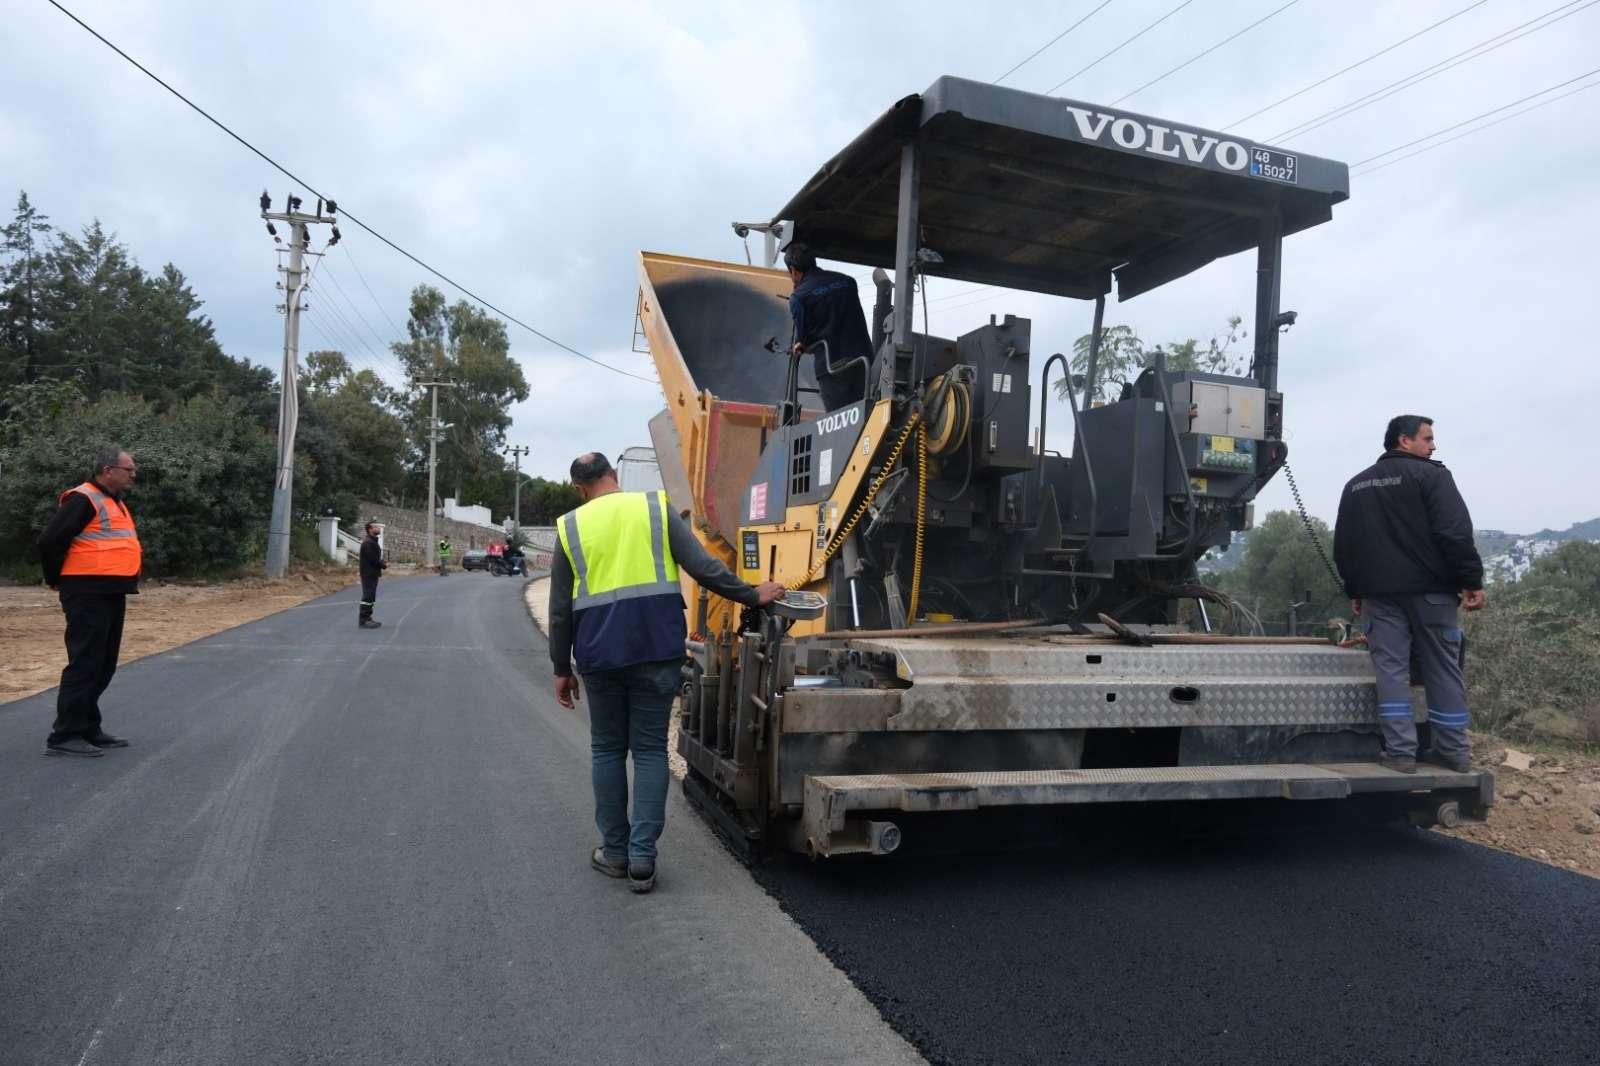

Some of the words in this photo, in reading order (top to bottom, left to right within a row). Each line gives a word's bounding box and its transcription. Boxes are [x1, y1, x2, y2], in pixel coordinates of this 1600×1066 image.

[1066, 106, 1249, 171] VOLVO
[1254, 150, 1270, 163] 48
[1258, 163, 1293, 180] 15027
[816, 407, 860, 435] VOLVO
